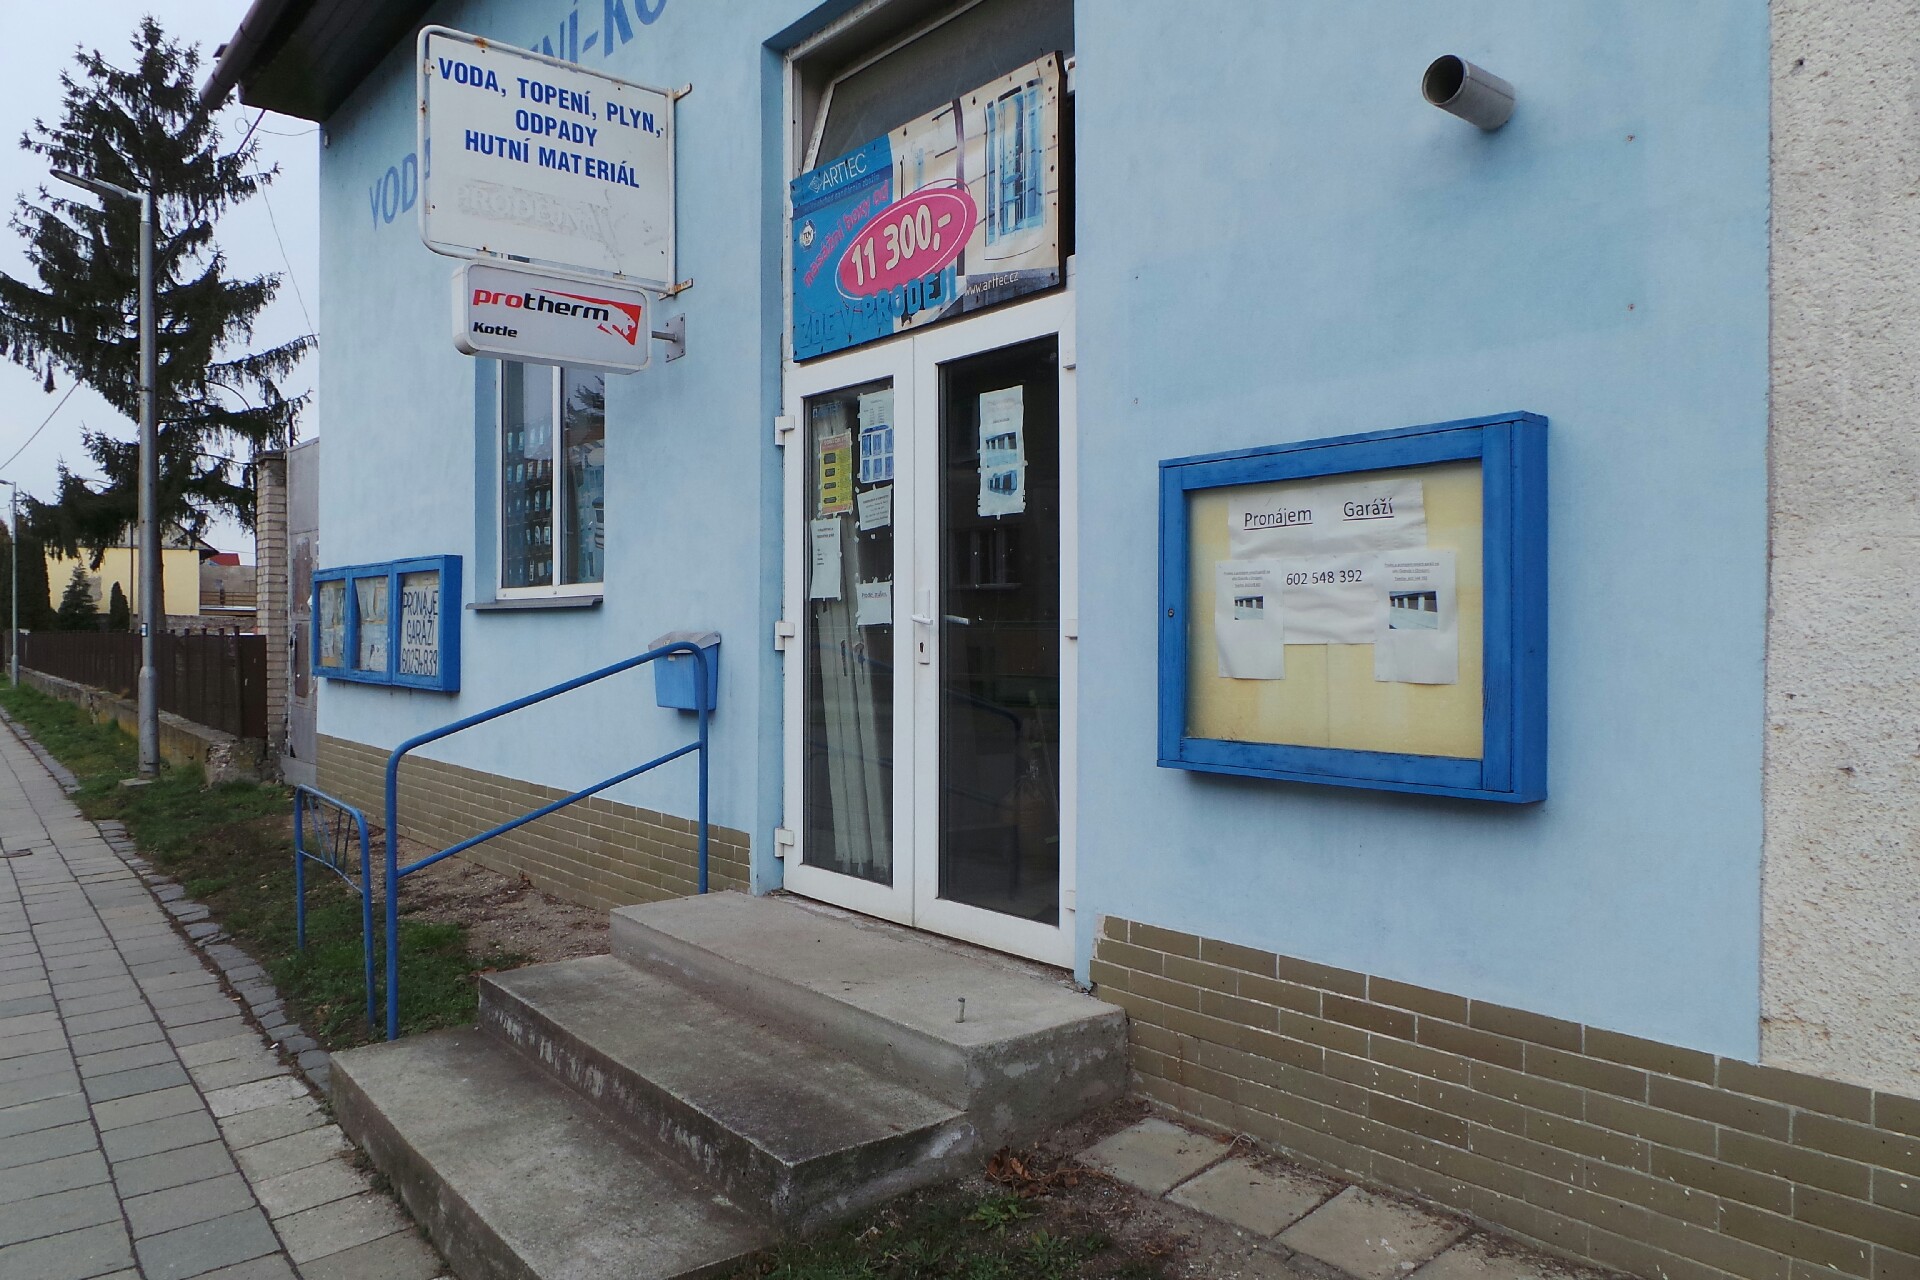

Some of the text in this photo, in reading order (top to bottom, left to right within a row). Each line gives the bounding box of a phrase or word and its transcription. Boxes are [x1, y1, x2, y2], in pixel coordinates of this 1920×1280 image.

[438, 57, 662, 138] VODA, TOPENÍ, PLYN,
[515, 109, 598, 148] ODPADY
[465, 129, 640, 189] HUTNÍ MATERIÁL
[822, 152, 867, 190] ARTTEC
[843, 196, 870, 232] boxy
[873, 179, 889, 206] od
[851, 203, 952, 286] 11 300,-
[964, 271, 1019, 297] www.arttec.cz
[472, 288, 610, 322] protherm
[473, 321, 518, 339] Kotle
[1244, 497, 1393, 528] Pronájem Garáží
[1286, 571, 1308, 586] 602
[1312, 570, 1334, 585] 548
[1340, 569, 1362, 584] 392
[406, 615, 435, 646] GARÁŽÍ
